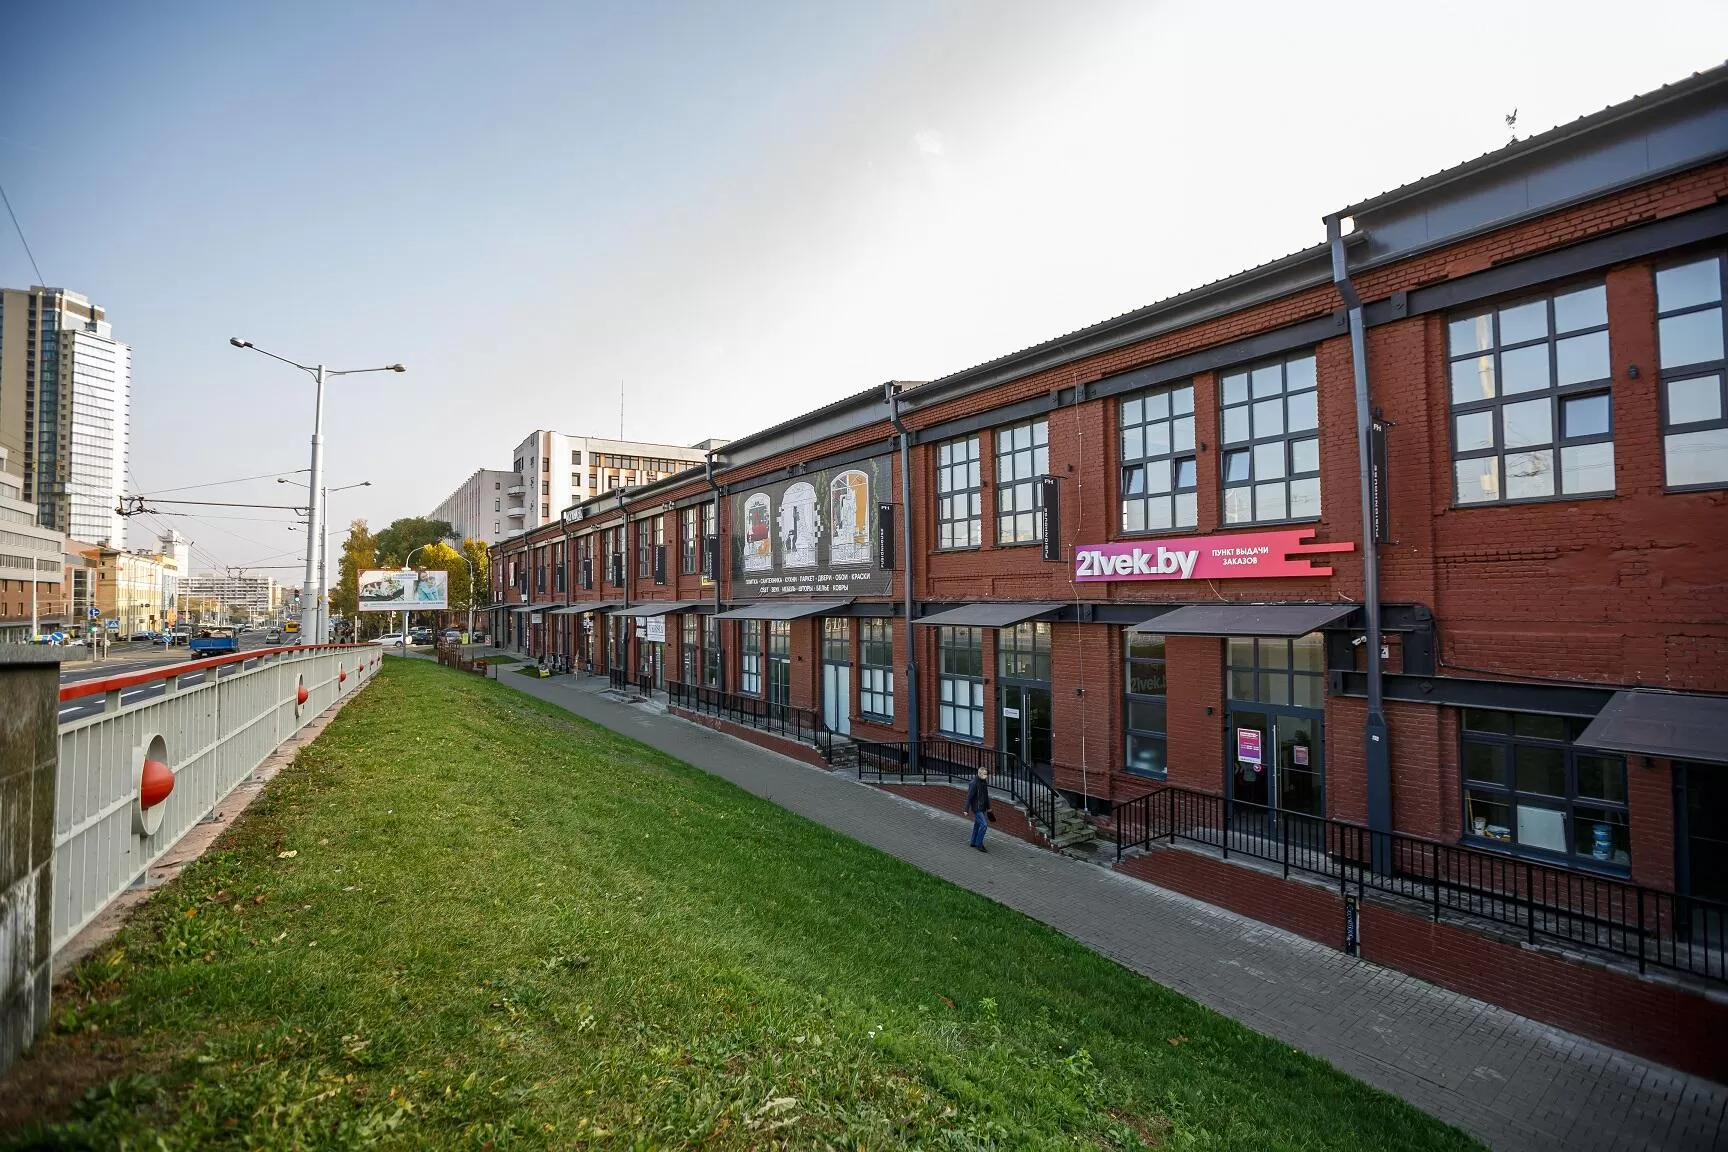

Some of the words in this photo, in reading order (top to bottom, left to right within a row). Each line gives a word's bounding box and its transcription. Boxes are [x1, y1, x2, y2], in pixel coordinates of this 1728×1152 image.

[1211, 548, 1235, 557] ПУНКТ
[1235, 546, 1269, 556] ВЫДАЧИ
[1076, 546, 1200, 580] 21vek.by
[1222, 556, 1258, 566] ЗАКАЗОВ
[817, 574, 832, 582] ДВЕРИ
[851, 572, 871, 580] КРАСКИ
